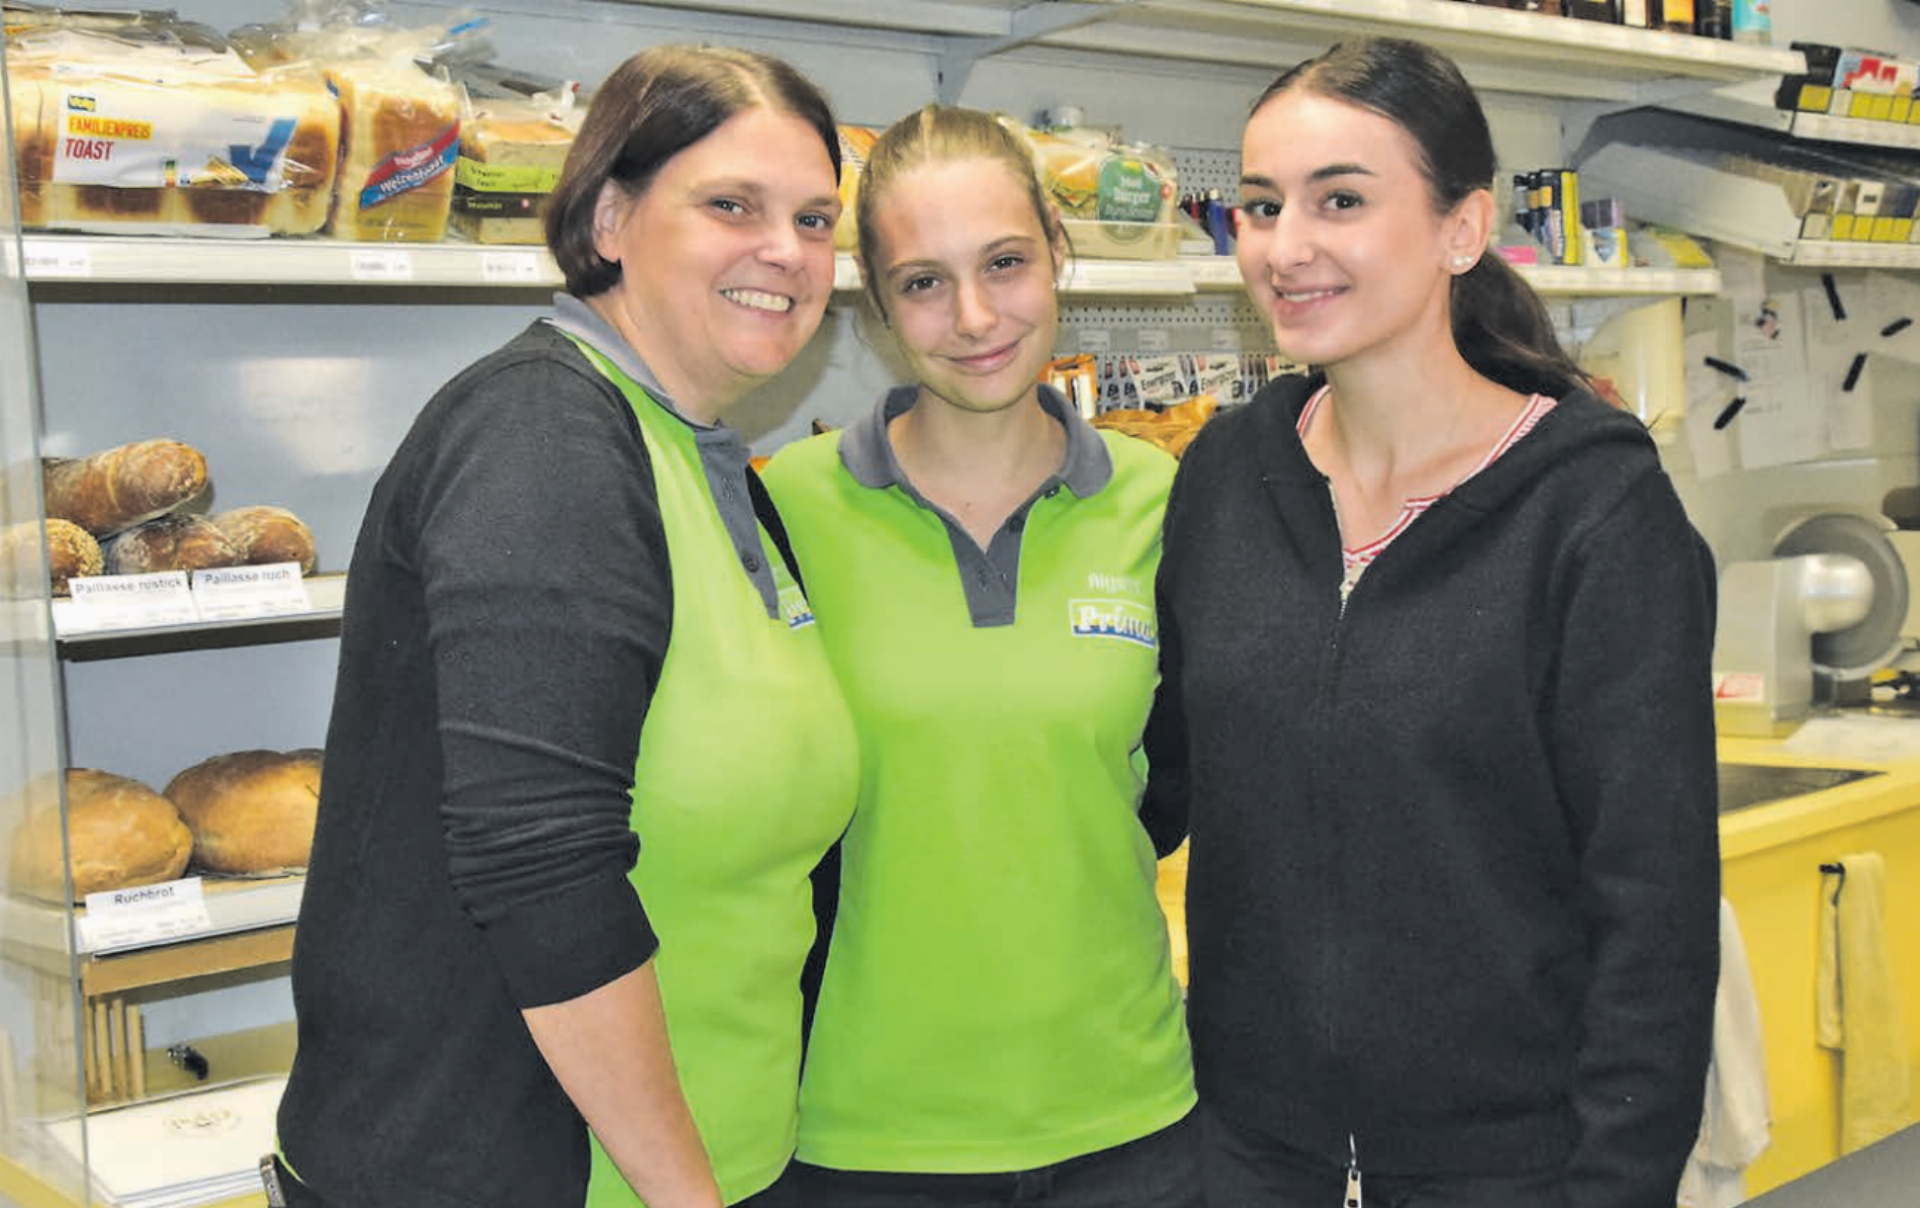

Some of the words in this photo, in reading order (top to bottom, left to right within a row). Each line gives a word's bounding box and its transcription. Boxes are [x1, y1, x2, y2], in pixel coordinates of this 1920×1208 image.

[69, 117, 151, 139] FAMILIENPREIS
[65, 138, 115, 161] TOAST
[204, 571, 260, 584] Paillasse
[262, 568, 291, 582] ruch
[75, 580, 134, 594] Paillasse
[114, 886, 176, 905] Ruchbrot
